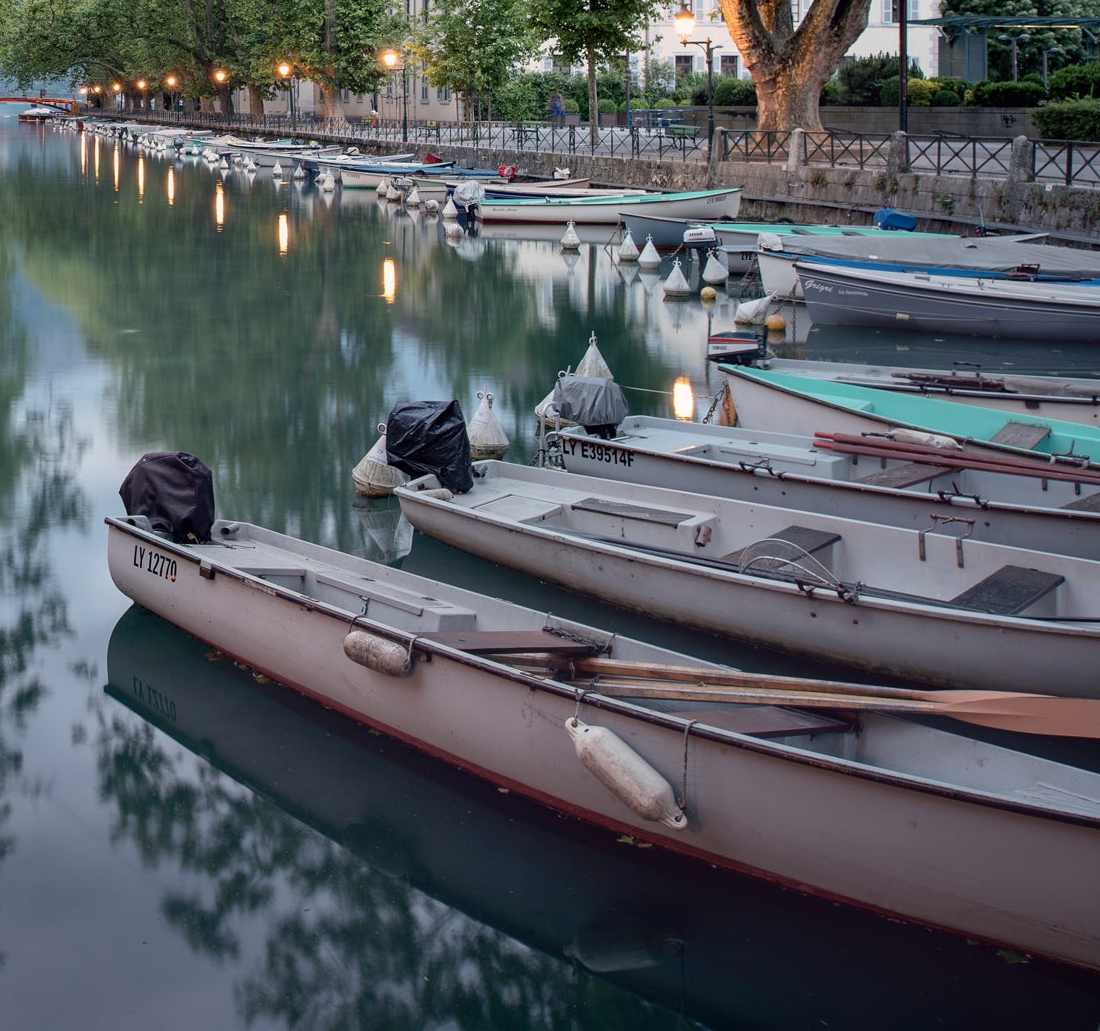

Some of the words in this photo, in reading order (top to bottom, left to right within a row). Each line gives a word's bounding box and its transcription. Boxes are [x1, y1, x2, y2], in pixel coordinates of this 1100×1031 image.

[804, 279, 834, 293] Grigri
[562, 439, 577, 456] LY
[581, 442, 635, 468] E39514F
[133, 545, 146, 569] LY
[147, 551, 177, 583] 12770
